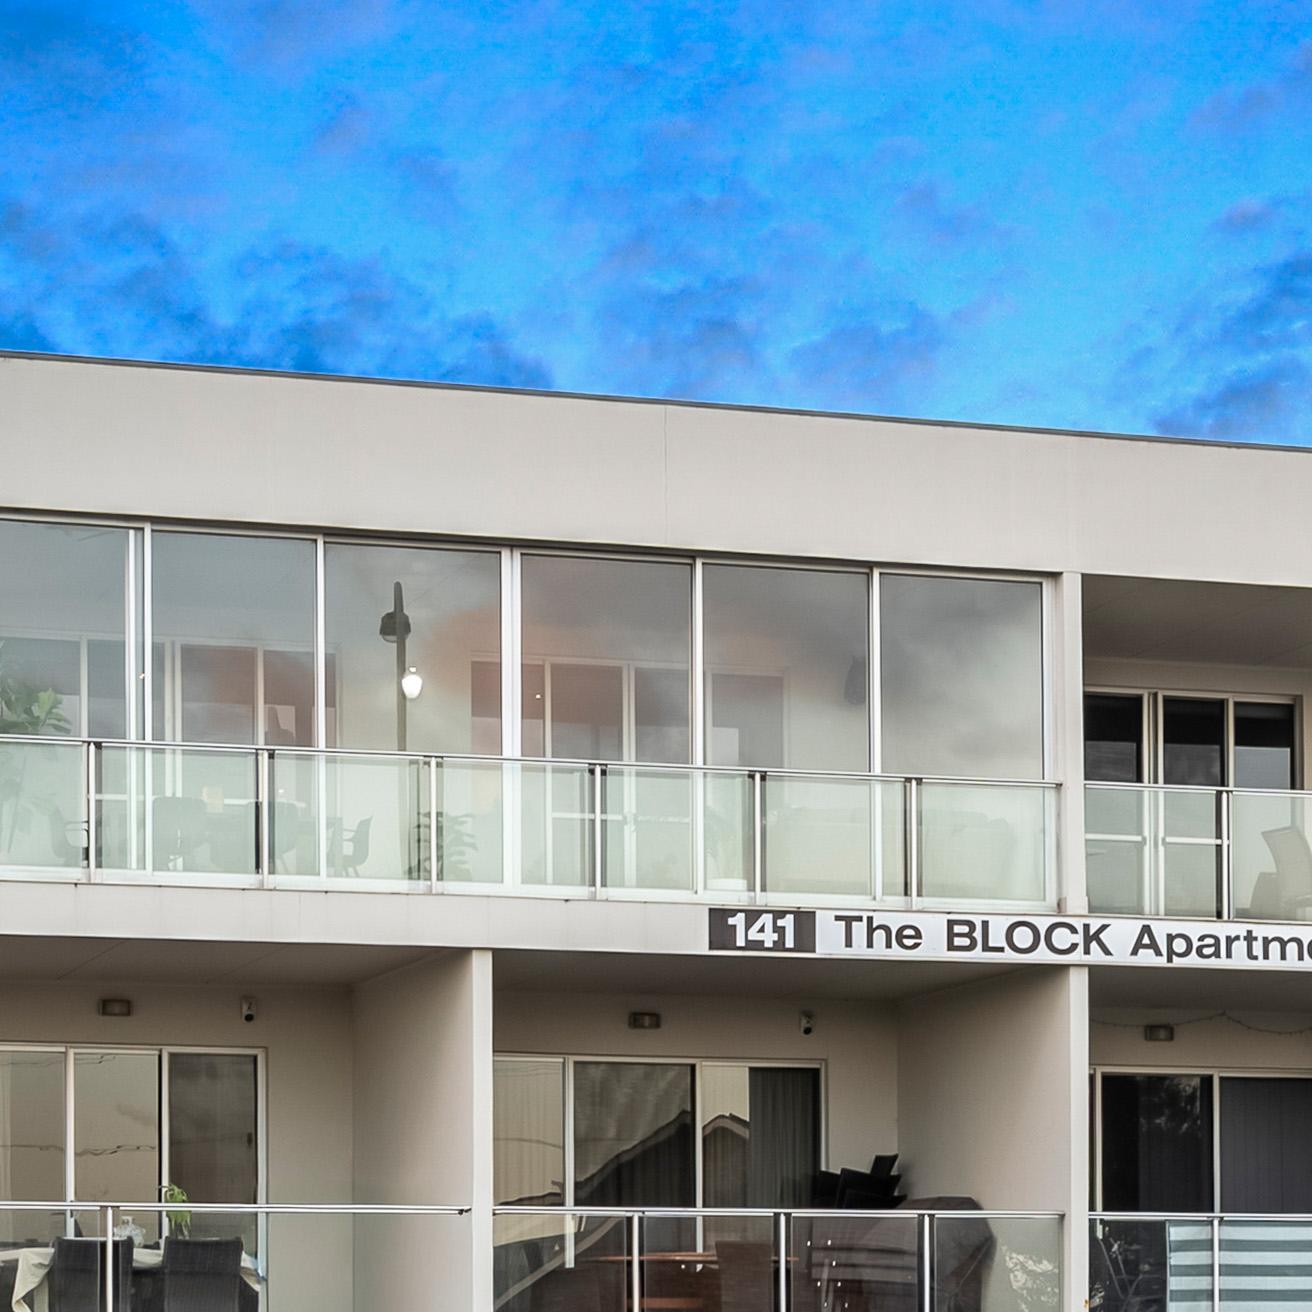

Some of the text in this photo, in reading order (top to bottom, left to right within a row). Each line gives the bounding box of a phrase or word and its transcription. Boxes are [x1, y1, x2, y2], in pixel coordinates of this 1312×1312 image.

[727, 911, 795, 949] 141
[834, 914, 923, 951] The
[946, 918, 1113, 957] BLOCK
